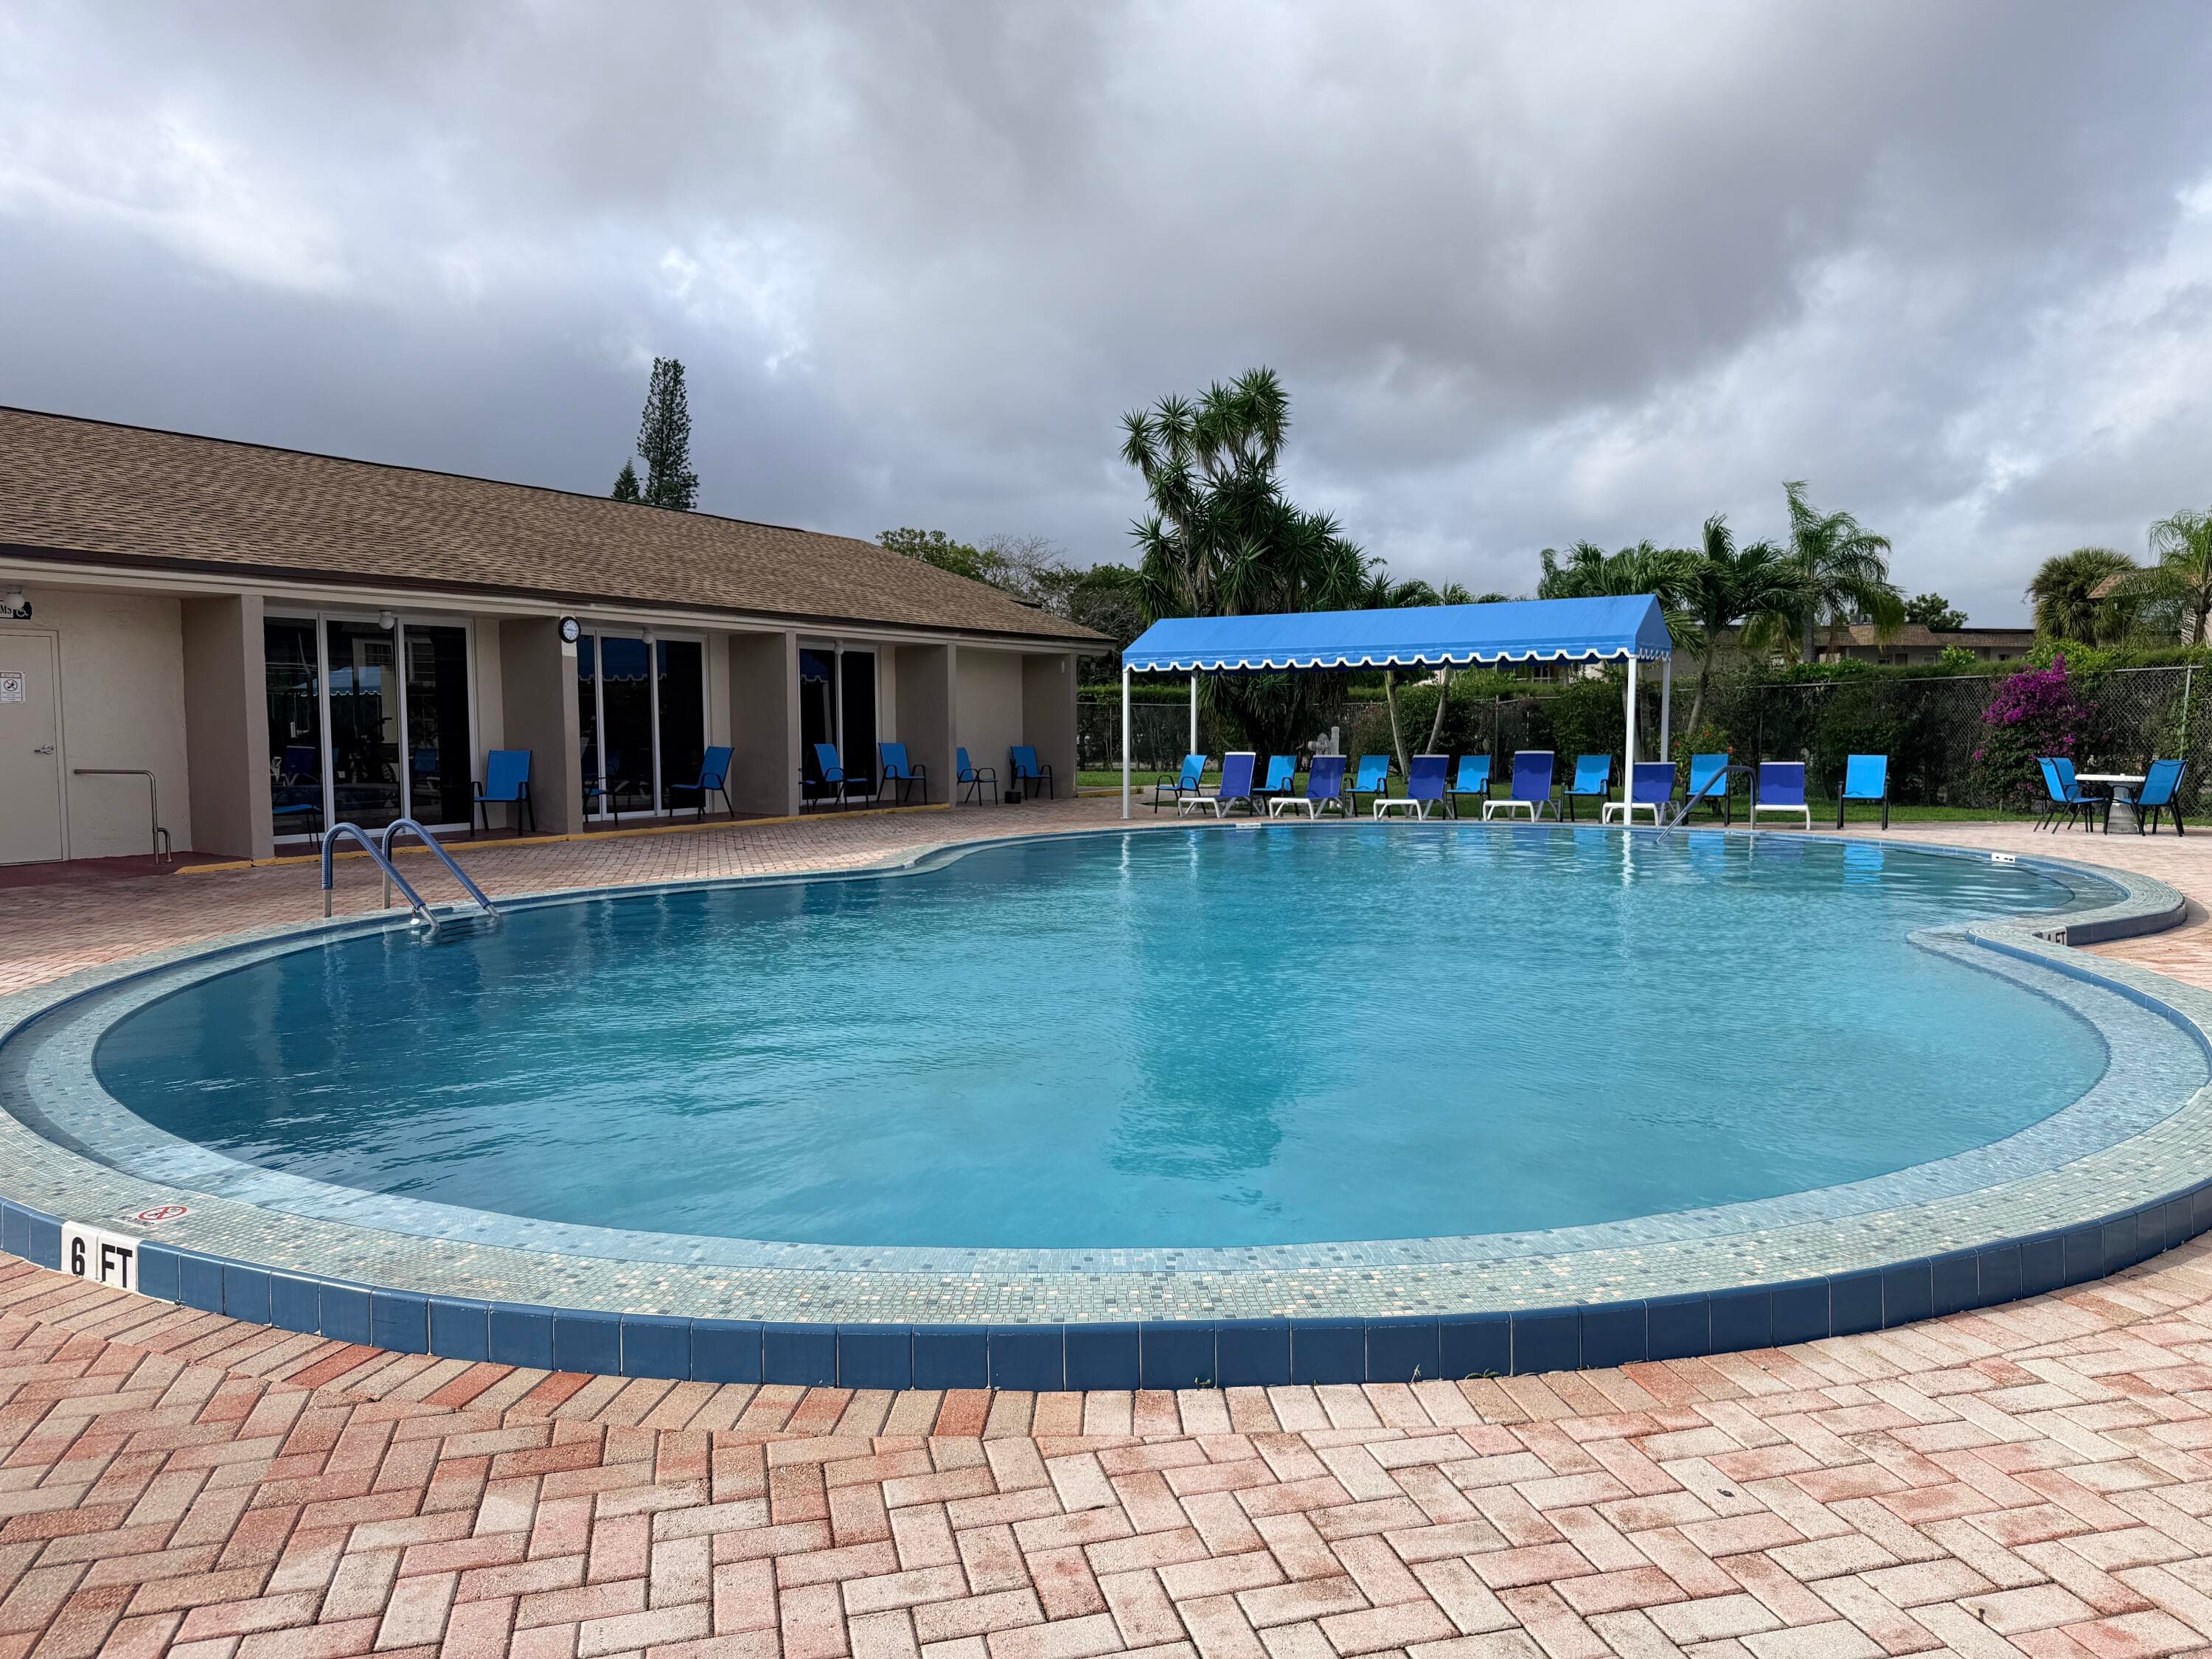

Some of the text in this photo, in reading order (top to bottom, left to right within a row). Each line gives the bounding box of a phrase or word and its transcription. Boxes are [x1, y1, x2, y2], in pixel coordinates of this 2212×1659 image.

[2055, 931, 2066, 945] FT
[71, 1237, 133, 1288] 6 FT
